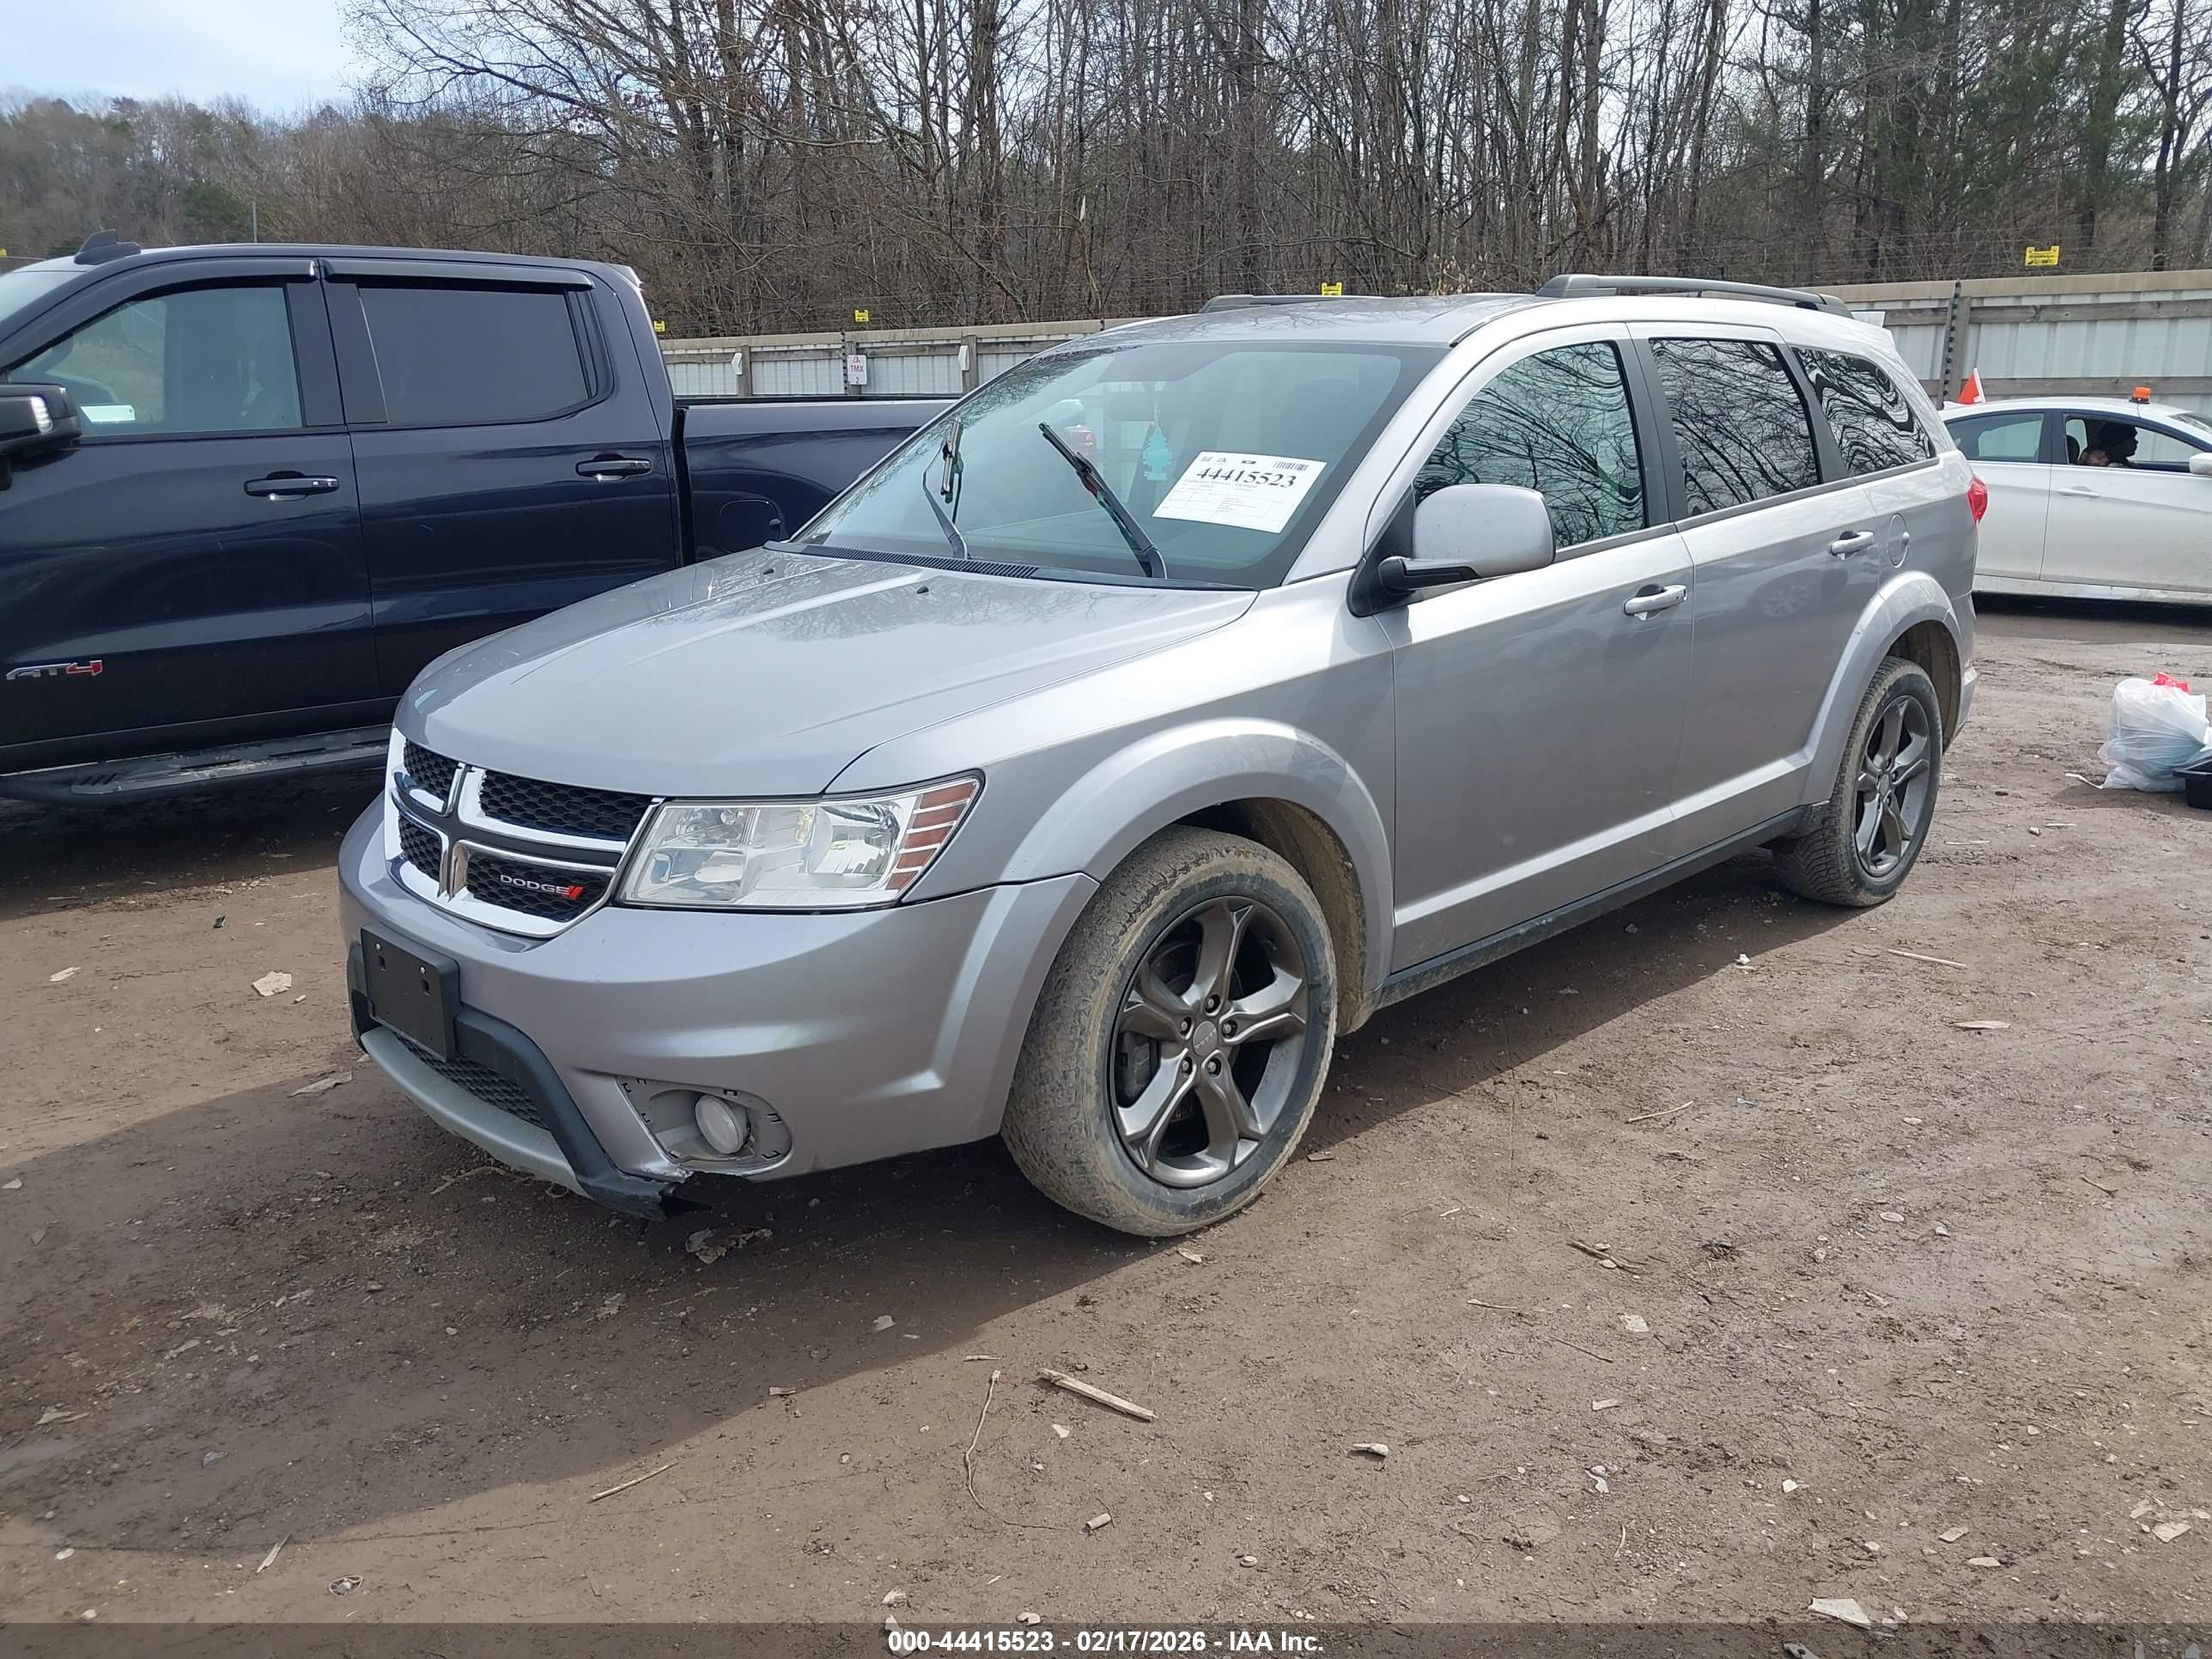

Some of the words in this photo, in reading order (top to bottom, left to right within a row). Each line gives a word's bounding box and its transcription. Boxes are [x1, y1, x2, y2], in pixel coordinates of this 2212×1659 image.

[1196, 467, 1297, 488] 44415523
[6, 659, 102, 680] AT4
[500, 874, 570, 895] DODGE
